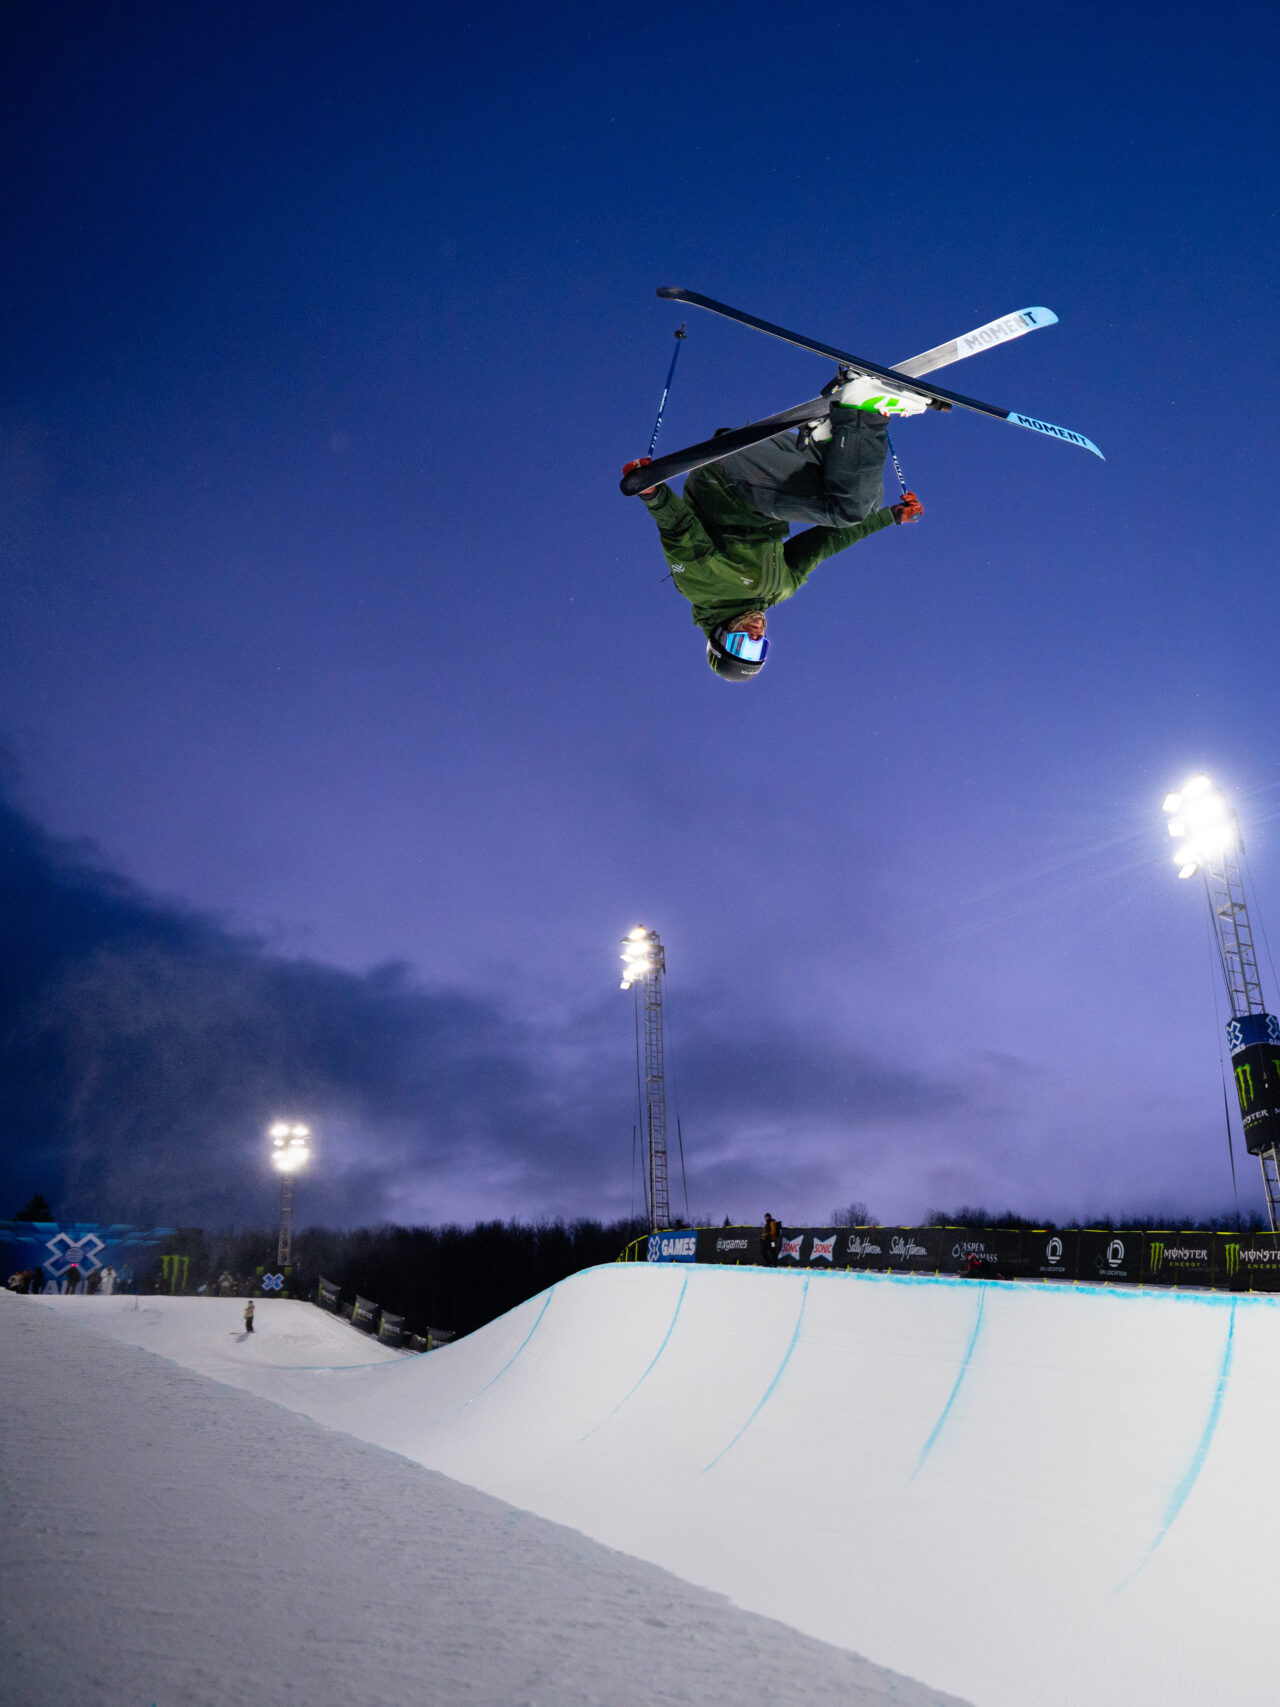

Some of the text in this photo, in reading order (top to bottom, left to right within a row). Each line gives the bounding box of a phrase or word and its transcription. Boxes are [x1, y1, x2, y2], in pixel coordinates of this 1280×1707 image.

[963, 311, 1037, 351] MOMENT
[1016, 415, 1088, 447] MOMENT
[661, 1237, 697, 1256] GAMES
[716, 1237, 749, 1251] @xgames
[781, 1242, 800, 1253] SONIC
[813, 1243, 833, 1254] SONIC
[961, 1242, 985, 1252] ASPEN
[1163, 1247, 1208, 1261] MONSTER
